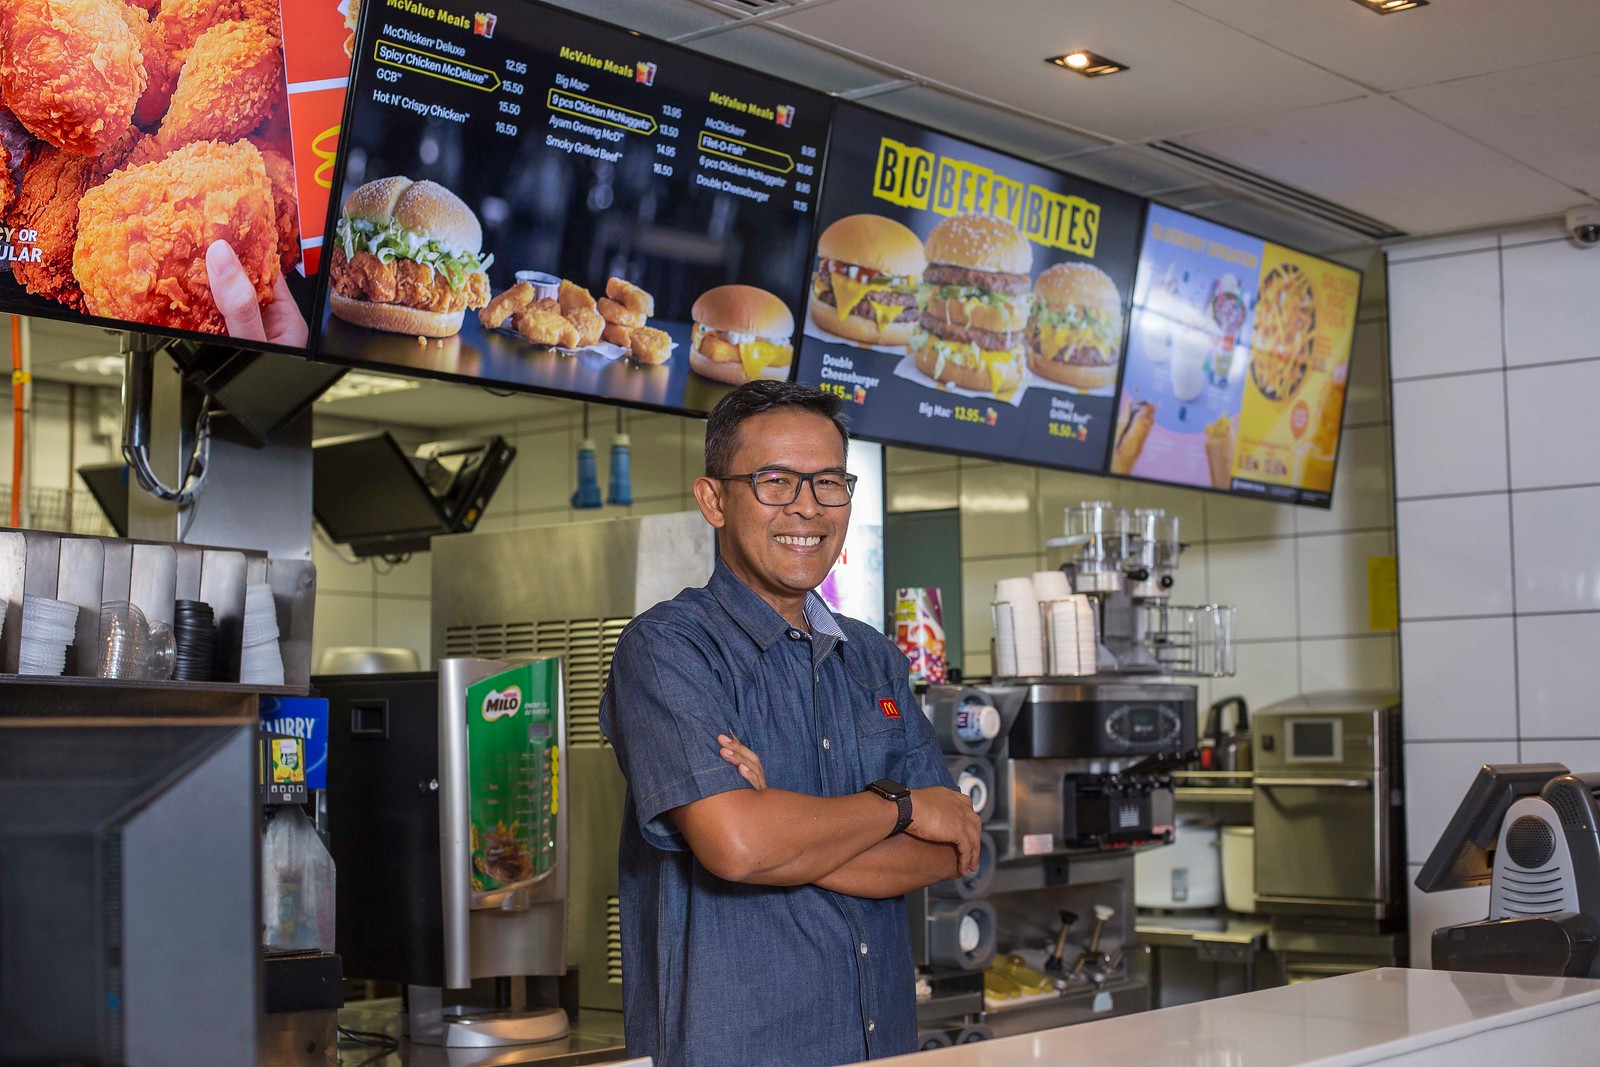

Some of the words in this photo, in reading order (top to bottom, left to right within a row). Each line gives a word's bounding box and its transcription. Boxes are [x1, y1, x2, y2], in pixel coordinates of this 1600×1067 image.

[437, 9, 470, 29] Meals
[436, 39, 466, 57] Deluxe
[505, 59, 528, 74] 12.95
[560, 46, 603, 68] McValue
[604, 60, 634, 78] Meals
[380, 46, 404, 64] Spicy
[406, 53, 441, 72] Chicken
[502, 80, 524, 95] 15.50
[498, 101, 521, 116] 15.50
[555, 74, 569, 89] Big
[662, 104, 682, 119] 13.95
[708, 91, 748, 112] McValue
[747, 102, 775, 120] Meals
[373, 90, 390, 104] Hot
[402, 97, 430, 116] Crispy
[495, 122, 518, 136] 16.50
[552, 94, 559, 104] 9
[558, 97, 574, 110] pcs
[574, 100, 606, 118] Chicken
[659, 124, 679, 138] 13.50
[546, 134, 574, 154] Smoky
[574, 142, 600, 158] Grilled
[548, 114, 572, 128] Ayam
[572, 120, 602, 140] Goreng
[656, 143, 676, 158] 14.95
[719, 160, 747, 177] Chicken
[696, 174, 722, 190] Double
[722, 180, 770, 203] Cheeseburger
[879, 146, 930, 198] BIG
[937, 163, 1020, 222] BEEFY
[1026, 190, 1096, 250] BITES
[18, 229, 38, 242] OR
[0, 245, 43, 263] ULAR
[822, 354, 854, 370] Double
[821, 367, 880, 389] Cheeseburger
[919, 402, 933, 418] Big
[486, 698, 518, 712] MILO
